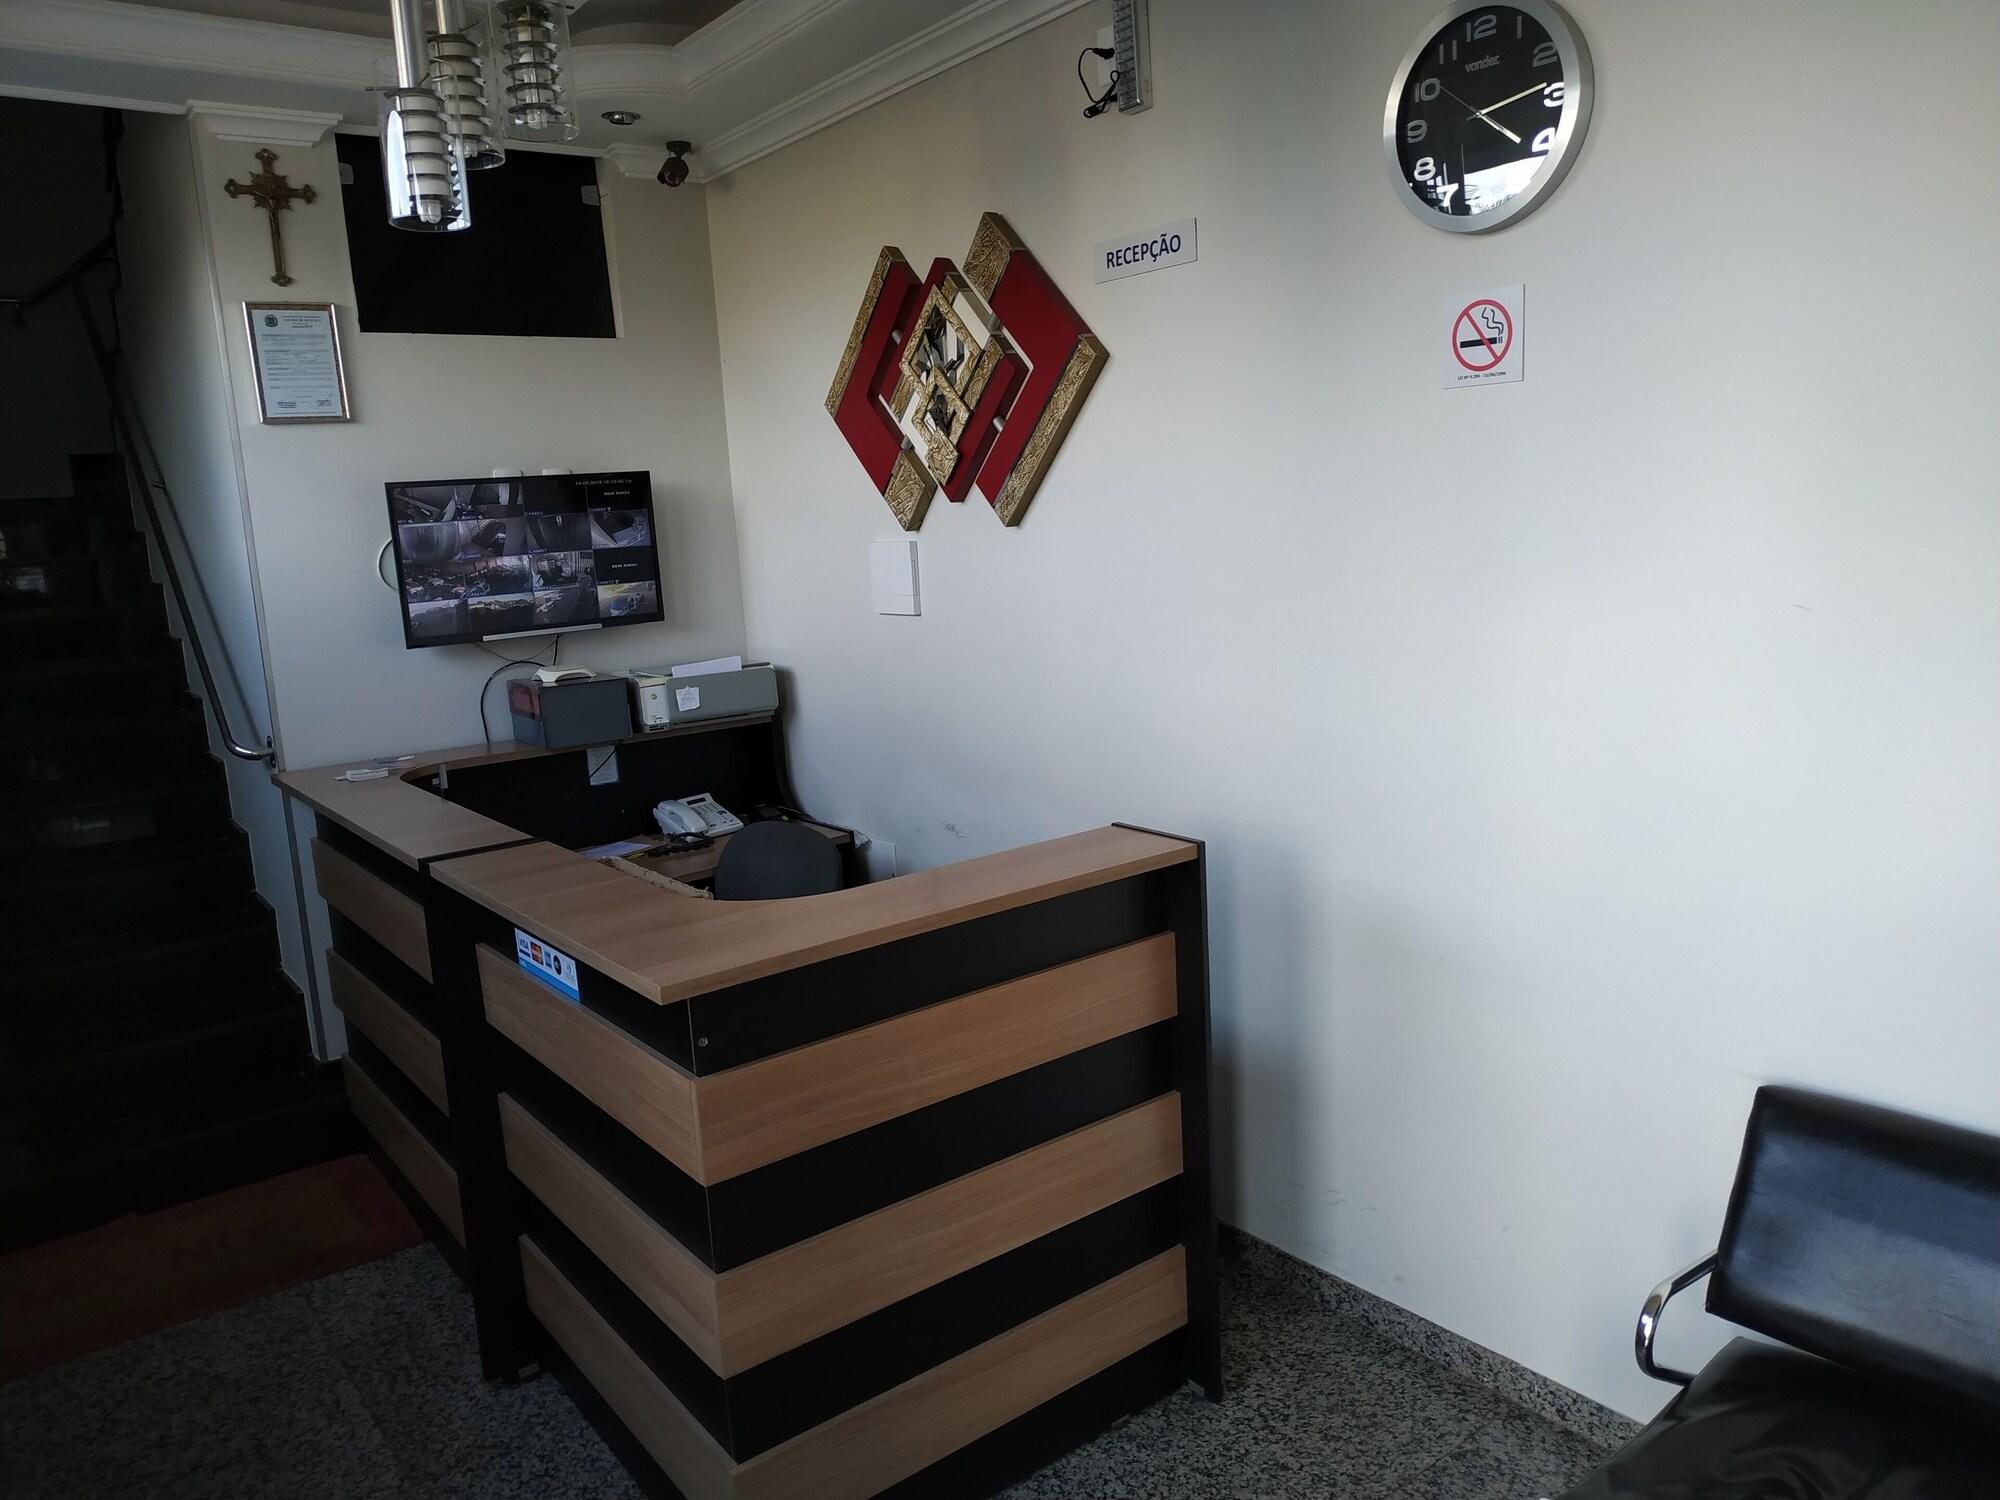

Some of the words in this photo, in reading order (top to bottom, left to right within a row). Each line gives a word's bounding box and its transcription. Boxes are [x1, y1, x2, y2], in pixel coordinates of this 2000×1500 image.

[1466, 14, 1497, 42] 12
[1516, 15, 1523, 39] 1
[1439, 39, 1458, 65] 11
[1532, 41, 1557, 67] 2
[1414, 77, 1441, 103] 10
[1543, 82, 1565, 107] 3
[1407, 119, 1427, 144] 9
[1413, 156, 1436, 182] 8
[1436, 183, 1459, 207] 7
[1106, 232, 1181, 269] RECEPÇÃO
